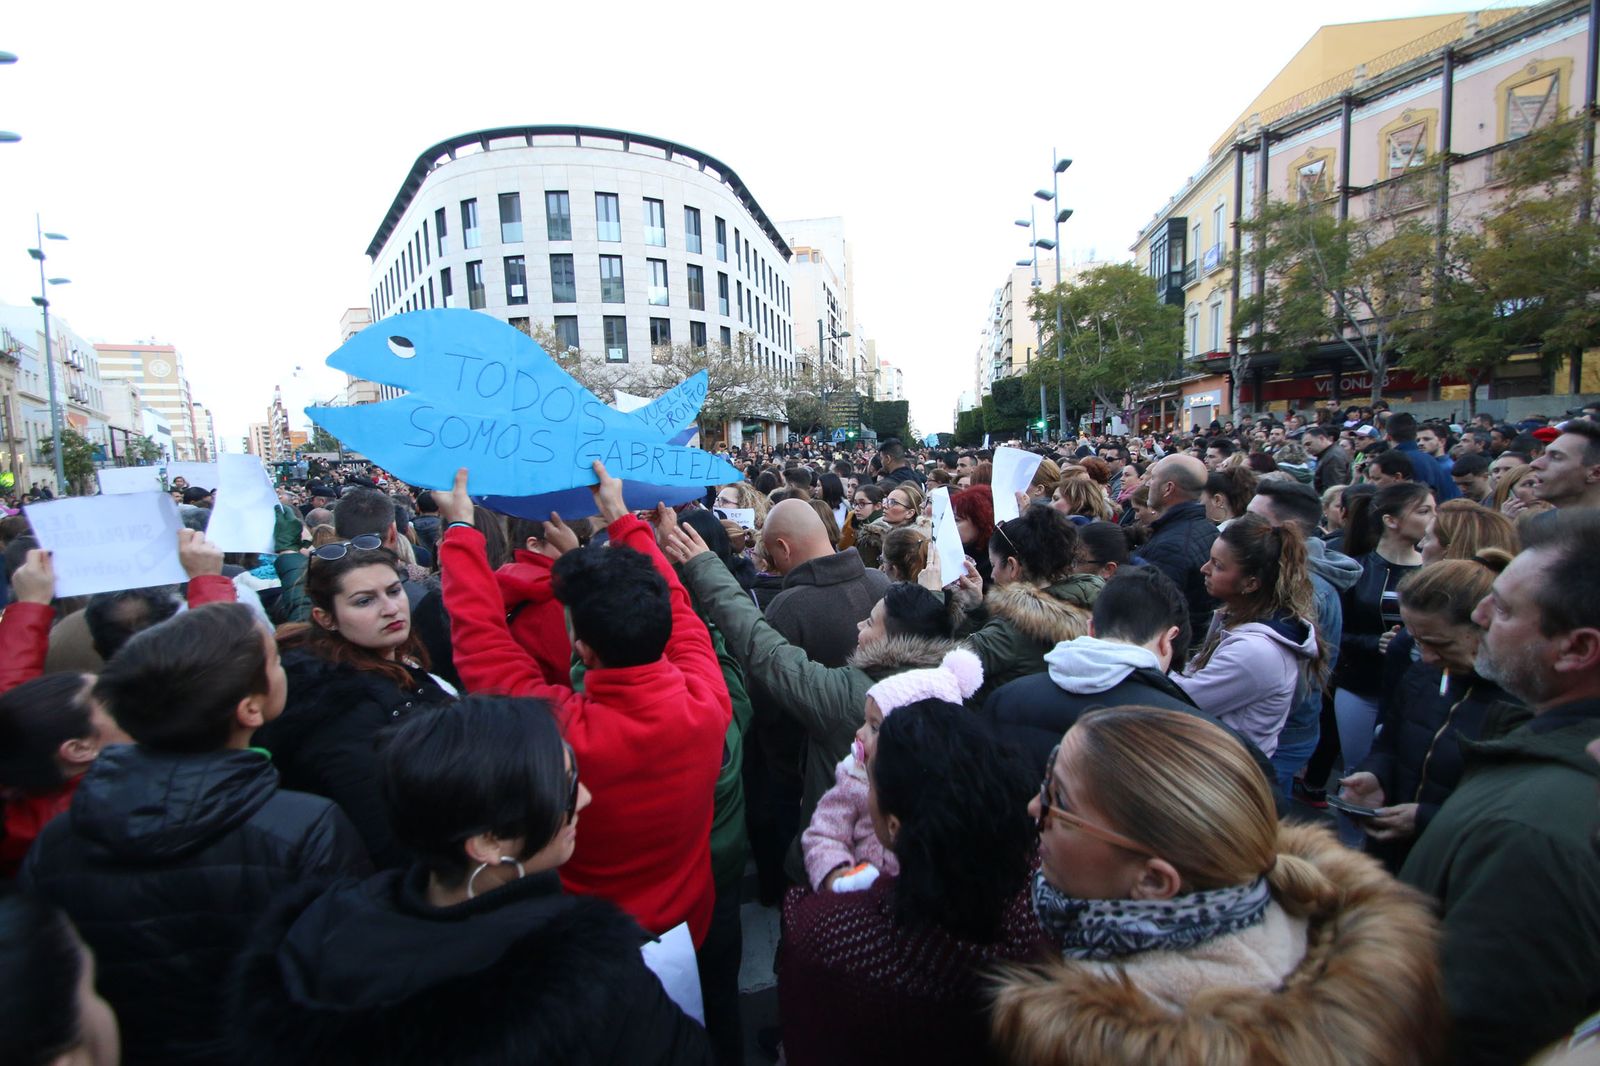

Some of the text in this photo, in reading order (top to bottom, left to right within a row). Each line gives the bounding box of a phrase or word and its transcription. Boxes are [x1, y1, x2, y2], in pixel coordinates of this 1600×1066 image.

[445, 353, 606, 435] TODOS
[635, 381, 692, 426] VUELVE
[655, 383, 706, 435] PRONTO
[1315, 375, 1390, 392] VIONLB
[404, 406, 720, 480] SOMOS GABRIEL
